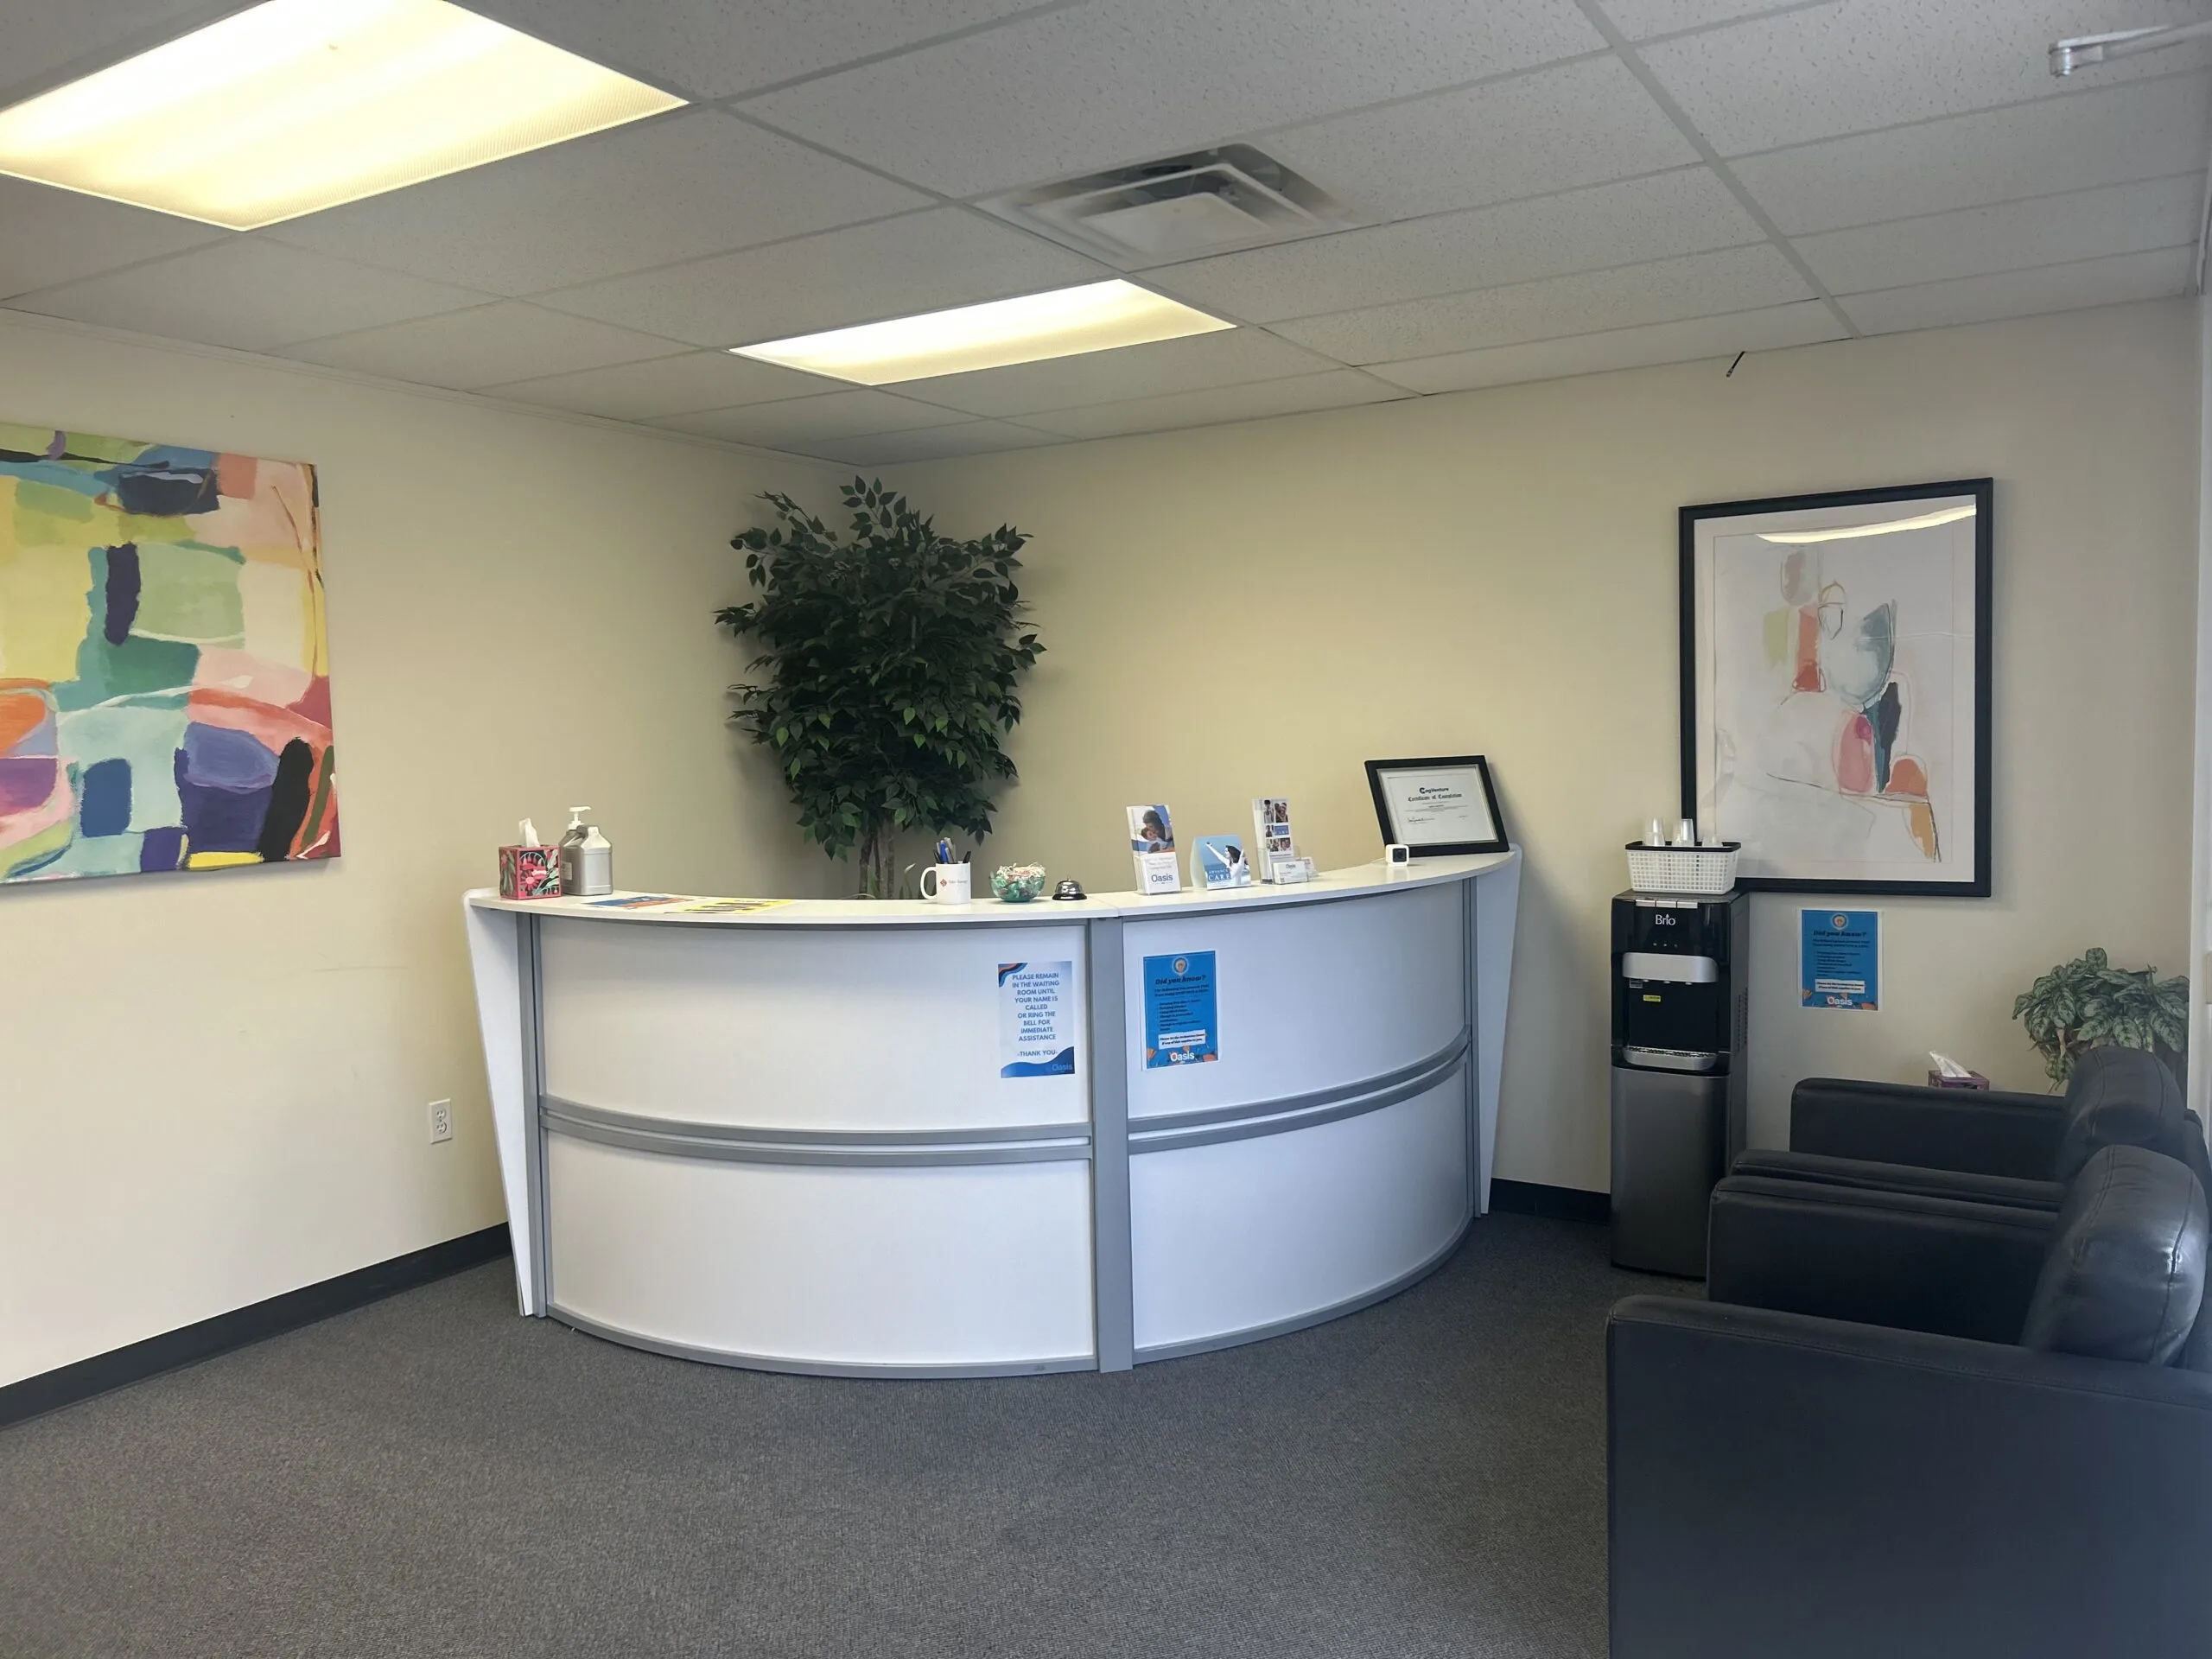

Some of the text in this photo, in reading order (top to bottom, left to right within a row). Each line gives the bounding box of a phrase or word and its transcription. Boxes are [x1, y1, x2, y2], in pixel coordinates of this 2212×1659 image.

[1152, 874, 1173, 882] Oasis
[1656, 914, 1675, 925] Brio
[1171, 1051, 1195, 1062] Oasis
